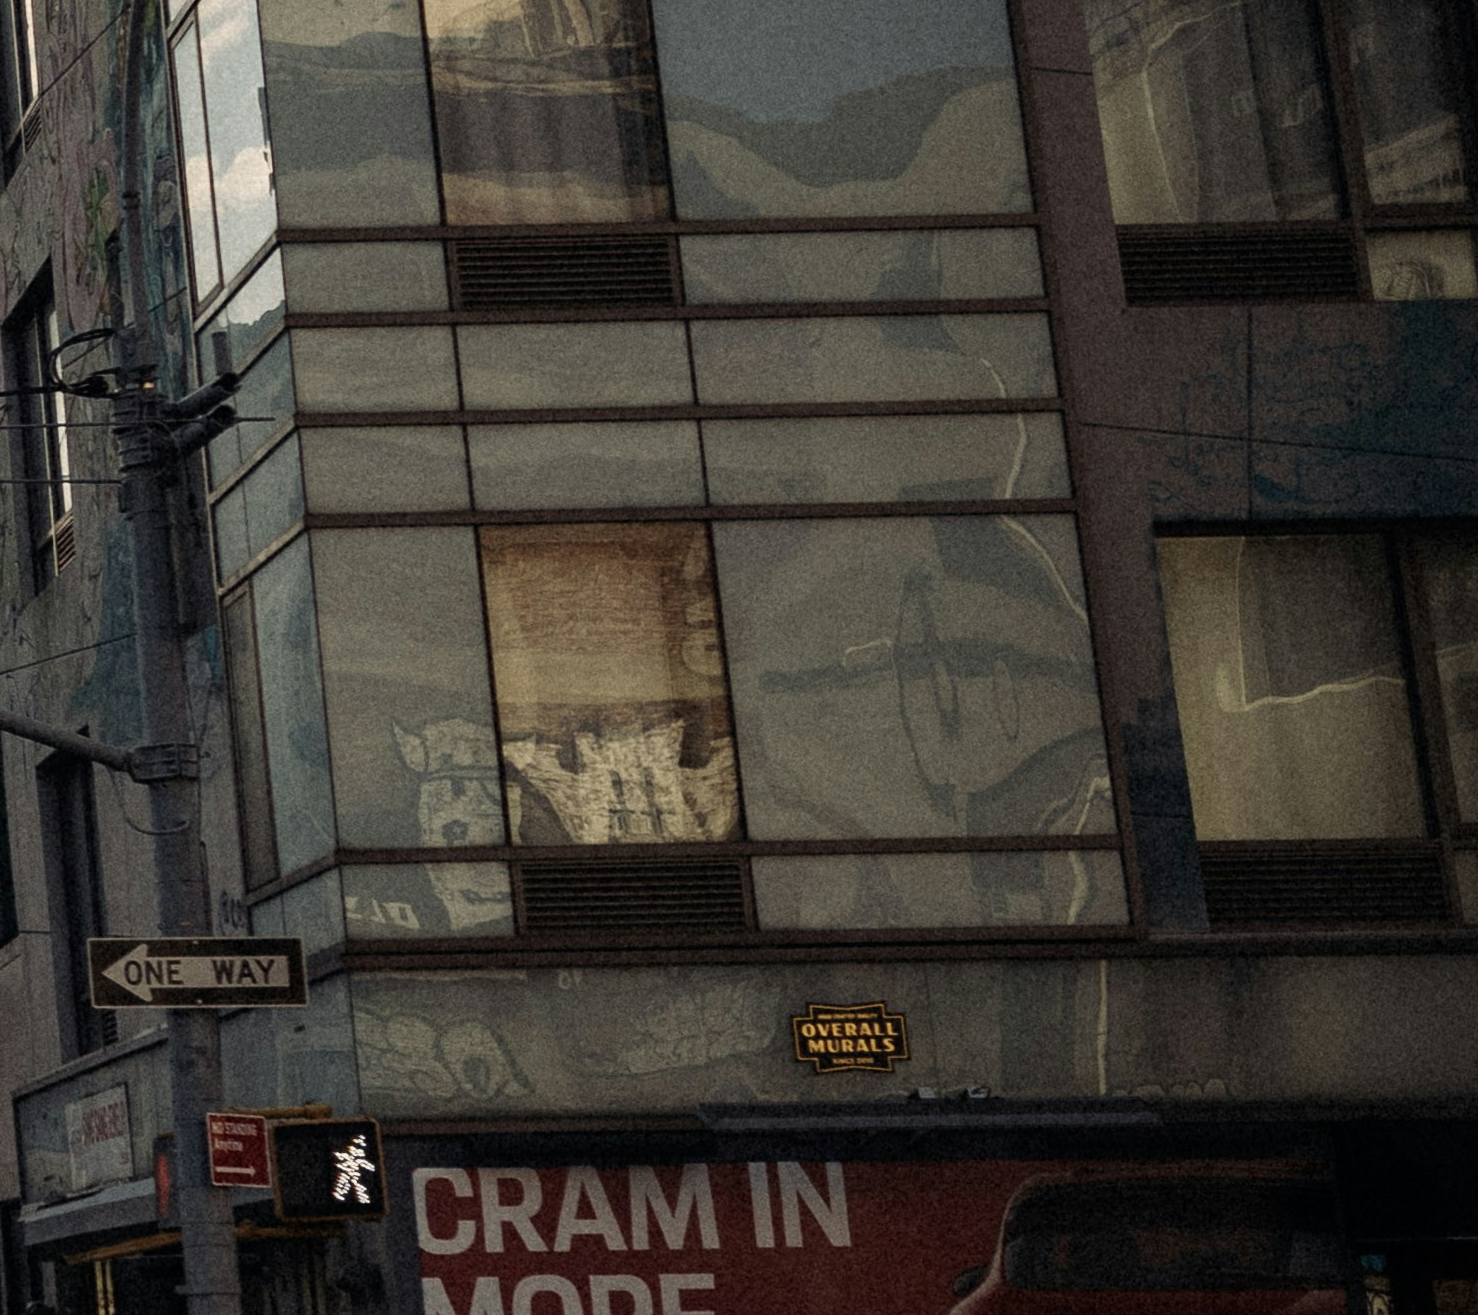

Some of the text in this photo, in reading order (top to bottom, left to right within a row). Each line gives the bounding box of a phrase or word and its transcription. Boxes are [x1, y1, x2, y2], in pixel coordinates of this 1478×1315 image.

[124, 959, 274, 985] ONE WAY
[801, 1022, 898, 1037] OVERALL
[808, 1038, 895, 1053] MURALS
[412, 1161, 852, 1255] CRAM IN
